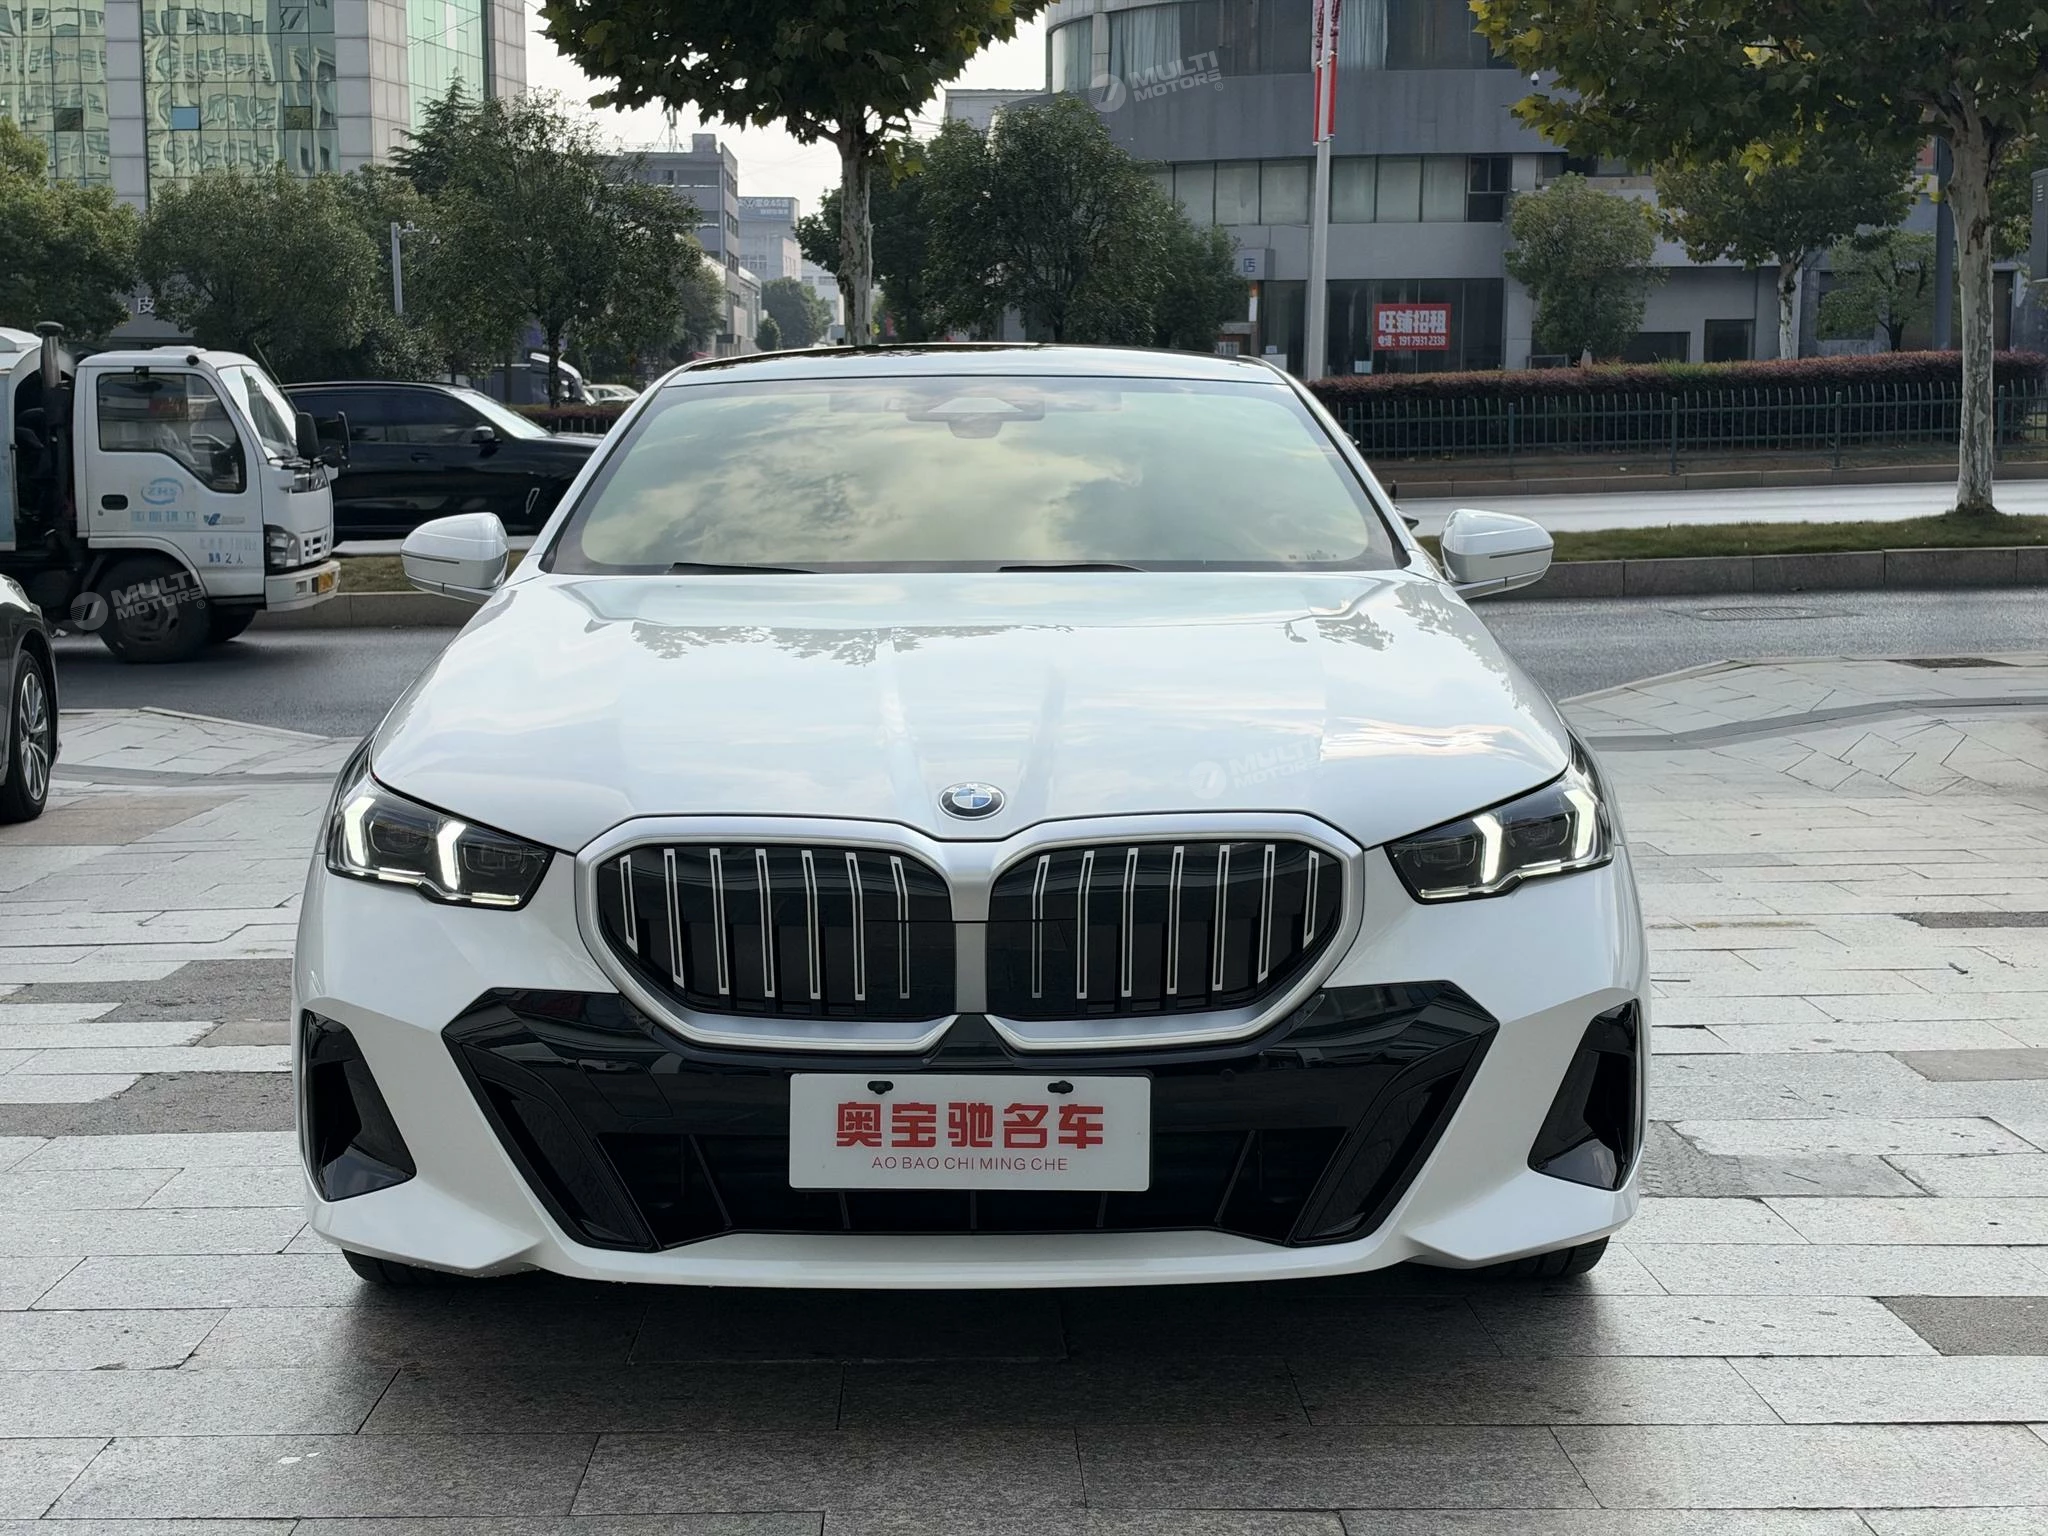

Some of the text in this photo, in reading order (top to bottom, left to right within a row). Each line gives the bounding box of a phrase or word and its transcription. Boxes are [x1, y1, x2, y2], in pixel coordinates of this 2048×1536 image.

[1379, 309, 1447, 334] 旺铺招租
[836, 1101, 1104, 1149] 奥宝驰名车
[872, 1157, 1068, 1171] AO BAO CHI MING CHE
